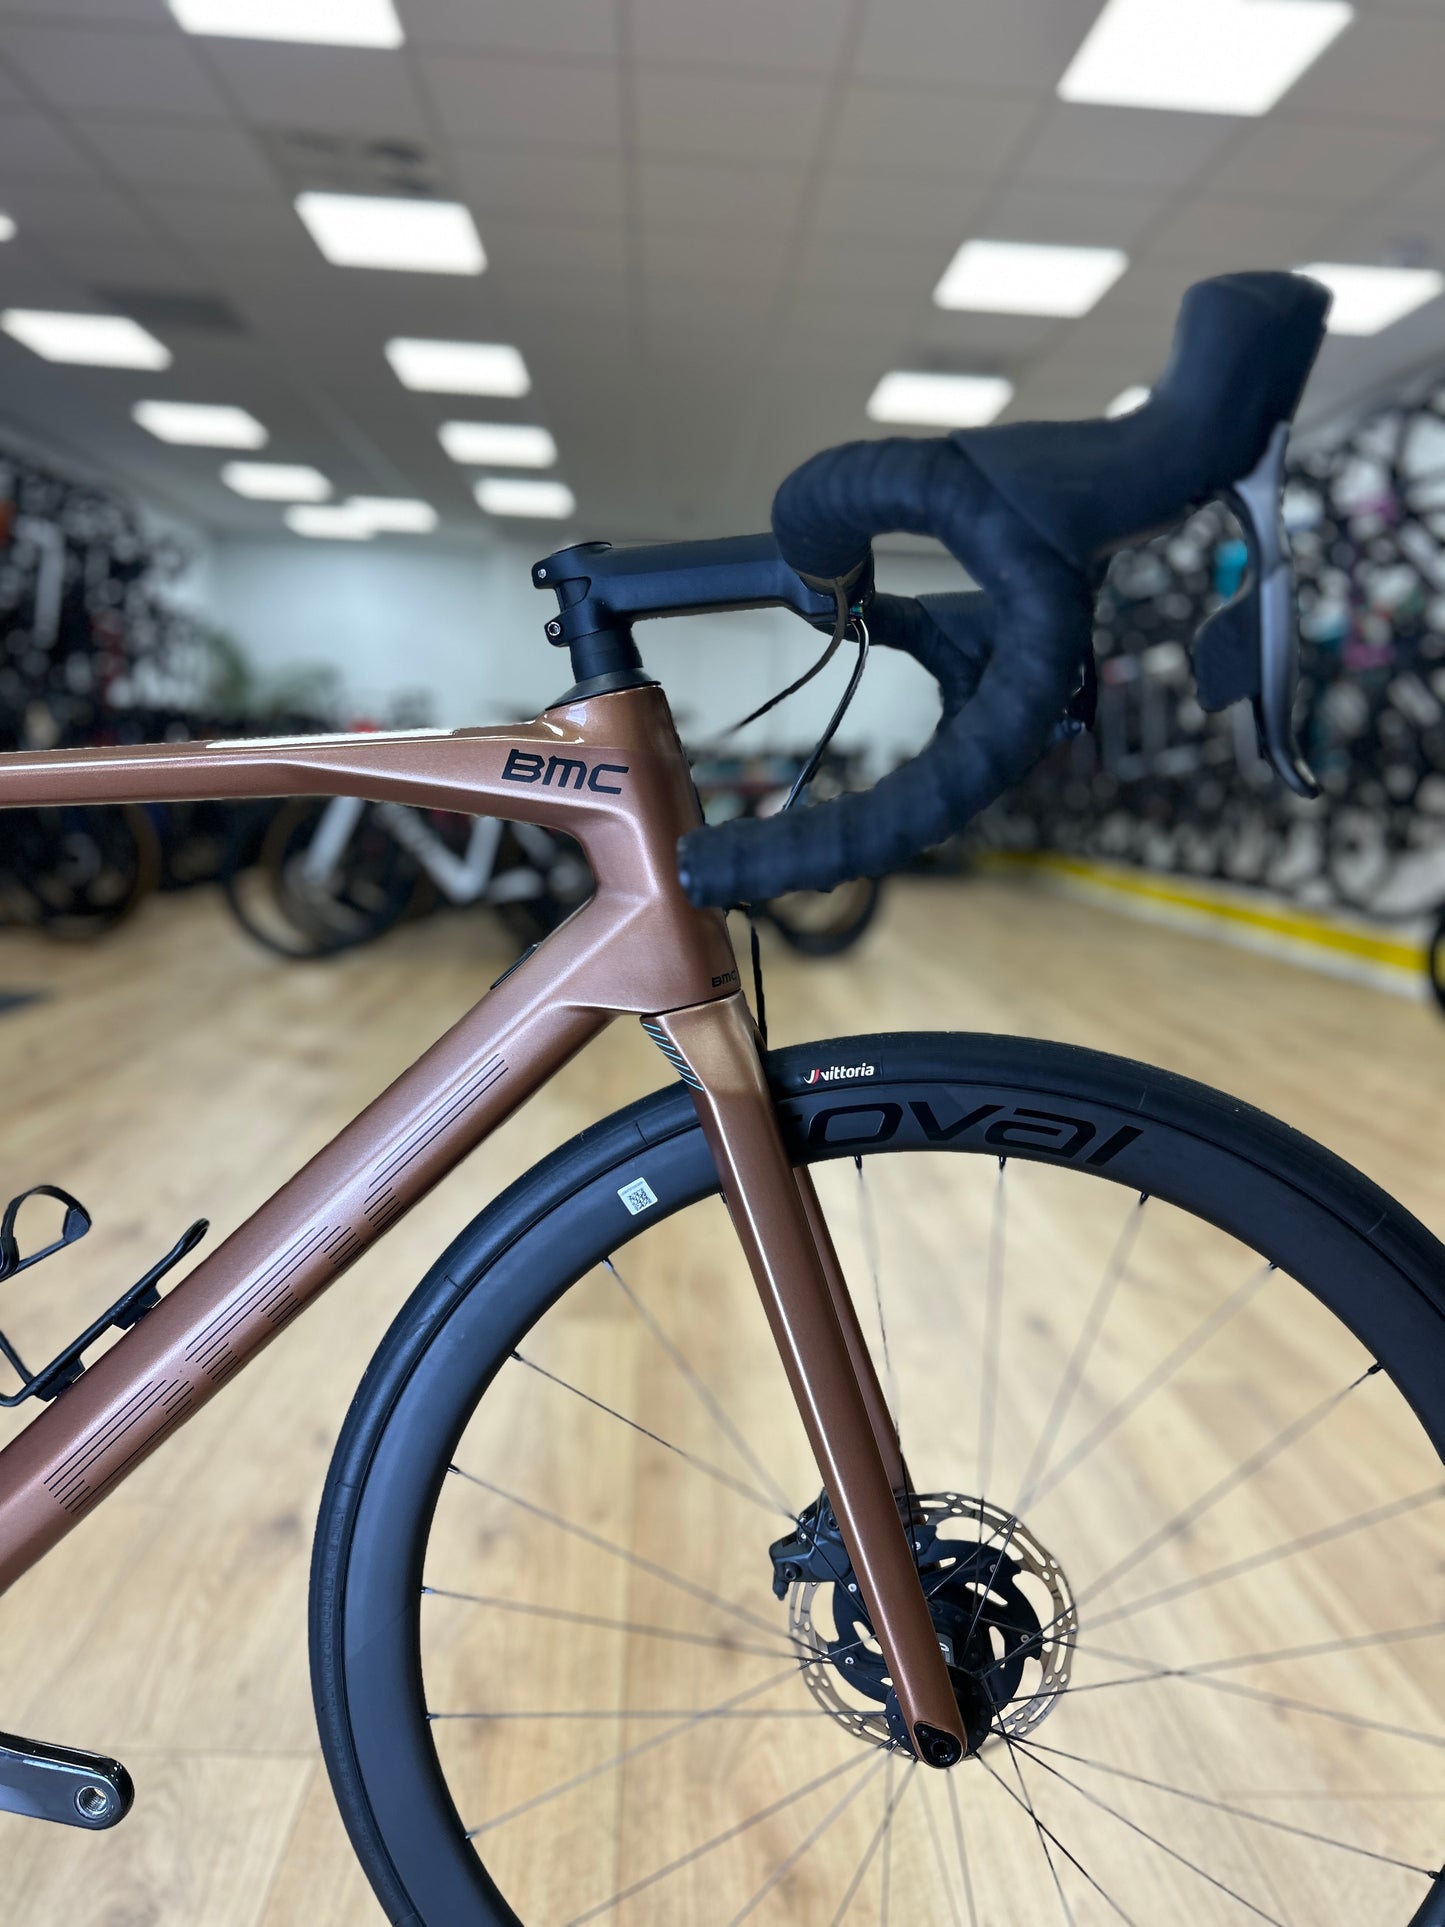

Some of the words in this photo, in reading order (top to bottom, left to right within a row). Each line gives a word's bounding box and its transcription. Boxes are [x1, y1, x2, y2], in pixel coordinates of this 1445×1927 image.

[501, 748, 629, 795] BMC
[712, 970, 737, 988] BMC
[820, 1062, 875, 1081] vittoria
[793, 1101, 1144, 1167] oval
